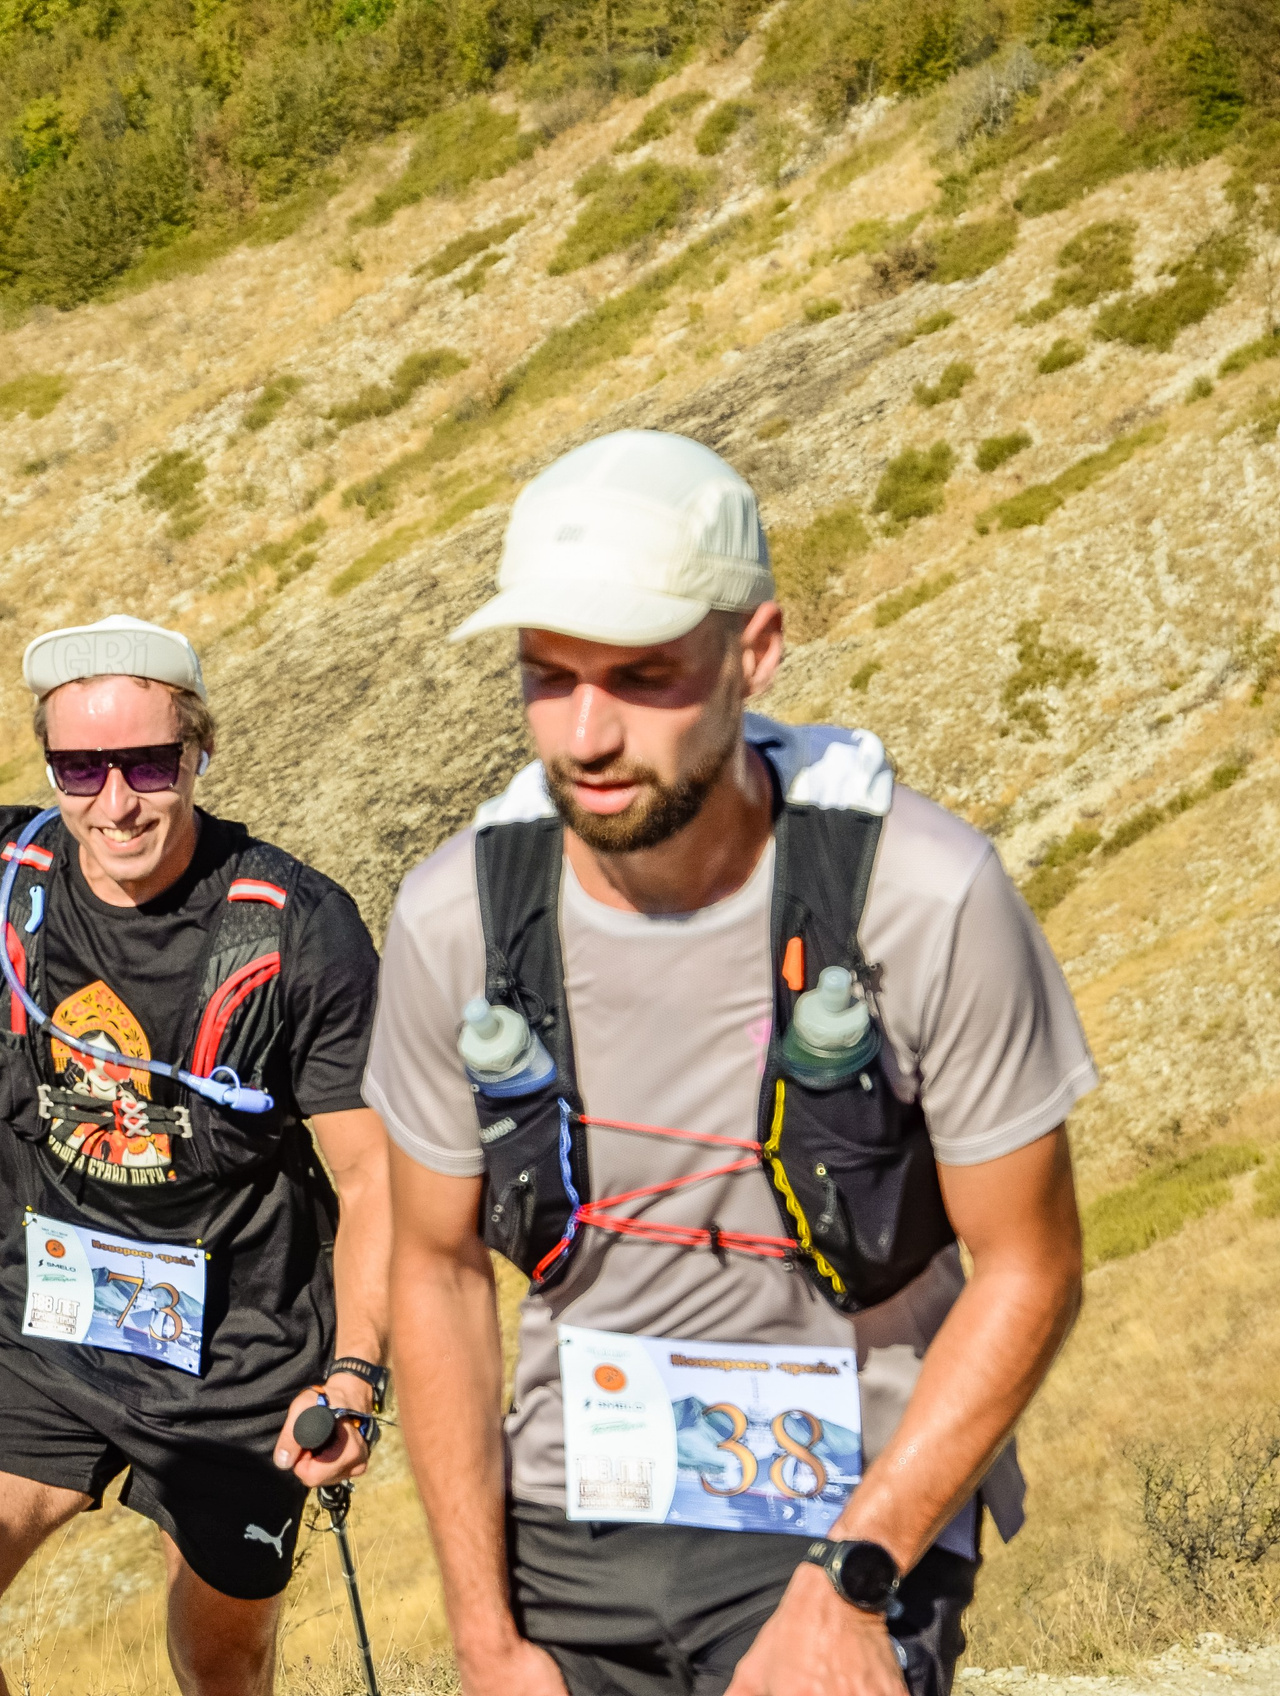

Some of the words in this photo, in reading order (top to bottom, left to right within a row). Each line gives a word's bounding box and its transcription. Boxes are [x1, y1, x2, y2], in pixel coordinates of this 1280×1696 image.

[87, 1157, 127, 1184] СТАЙЛ
[130, 1166, 166, 1185] ПАТИ
[46, 1261, 77, 1272] SMELO
[107, 1271, 183, 1341] 73
[701, 1402, 828, 1499] 38
